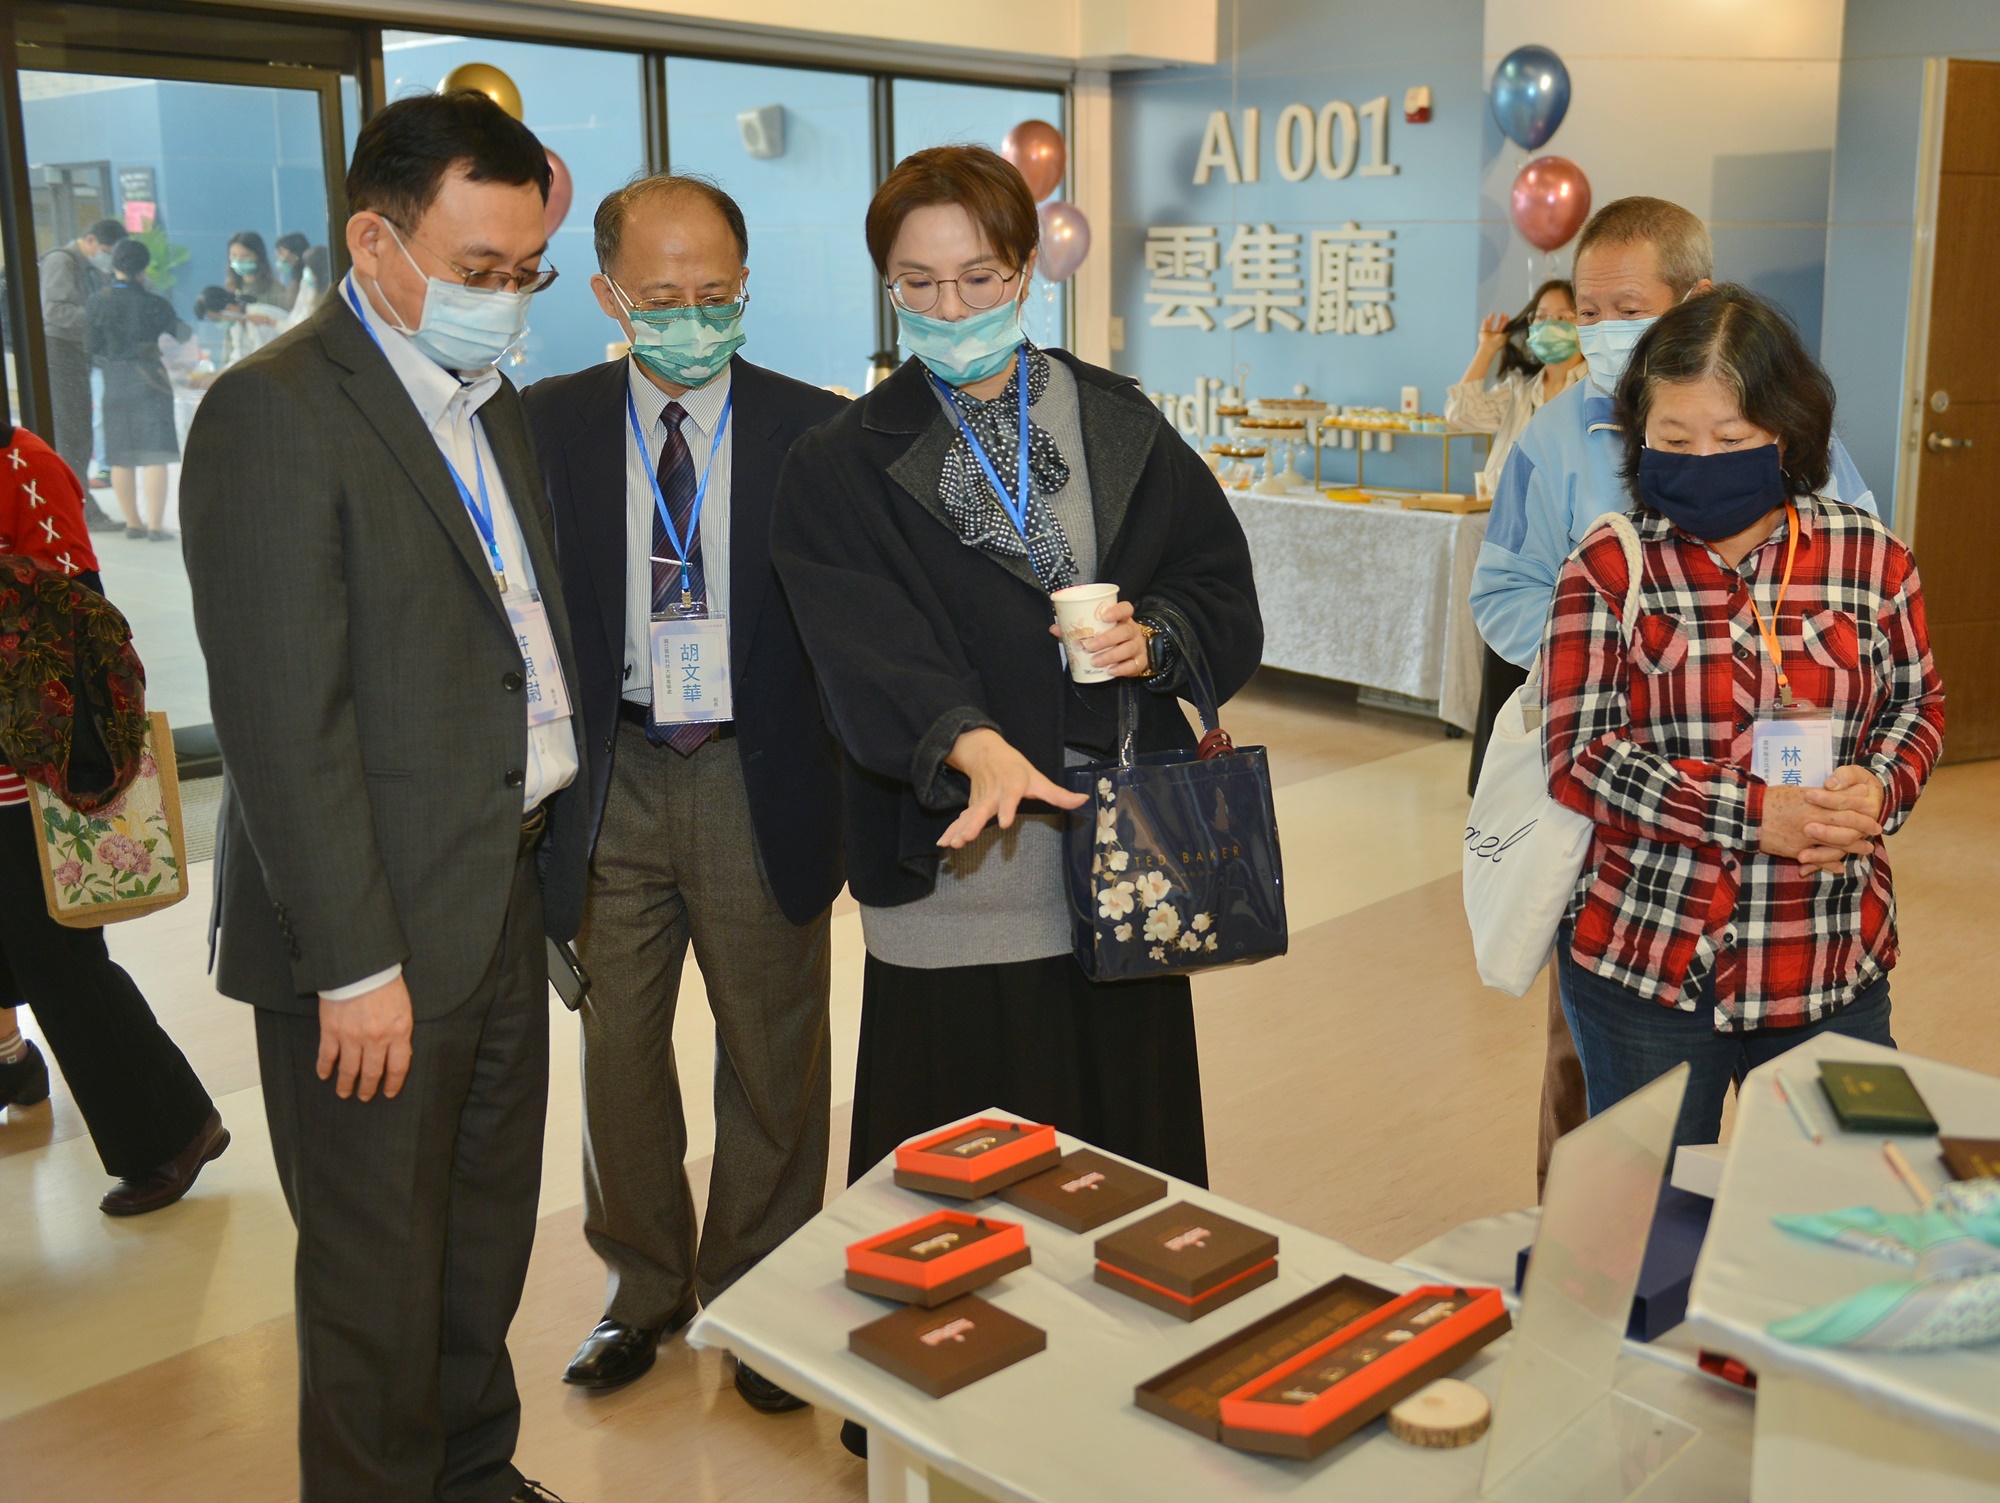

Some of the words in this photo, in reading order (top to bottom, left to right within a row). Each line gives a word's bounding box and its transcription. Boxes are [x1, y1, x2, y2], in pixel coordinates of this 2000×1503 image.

[1193, 107, 1261, 185] AI
[1275, 97, 1400, 182] 001
[1144, 220, 1396, 335] 雲集廳
[680, 643, 702, 702] 胡文華
[1134, 853, 1166, 867] TED
[1182, 845, 1239, 864] BAKER
